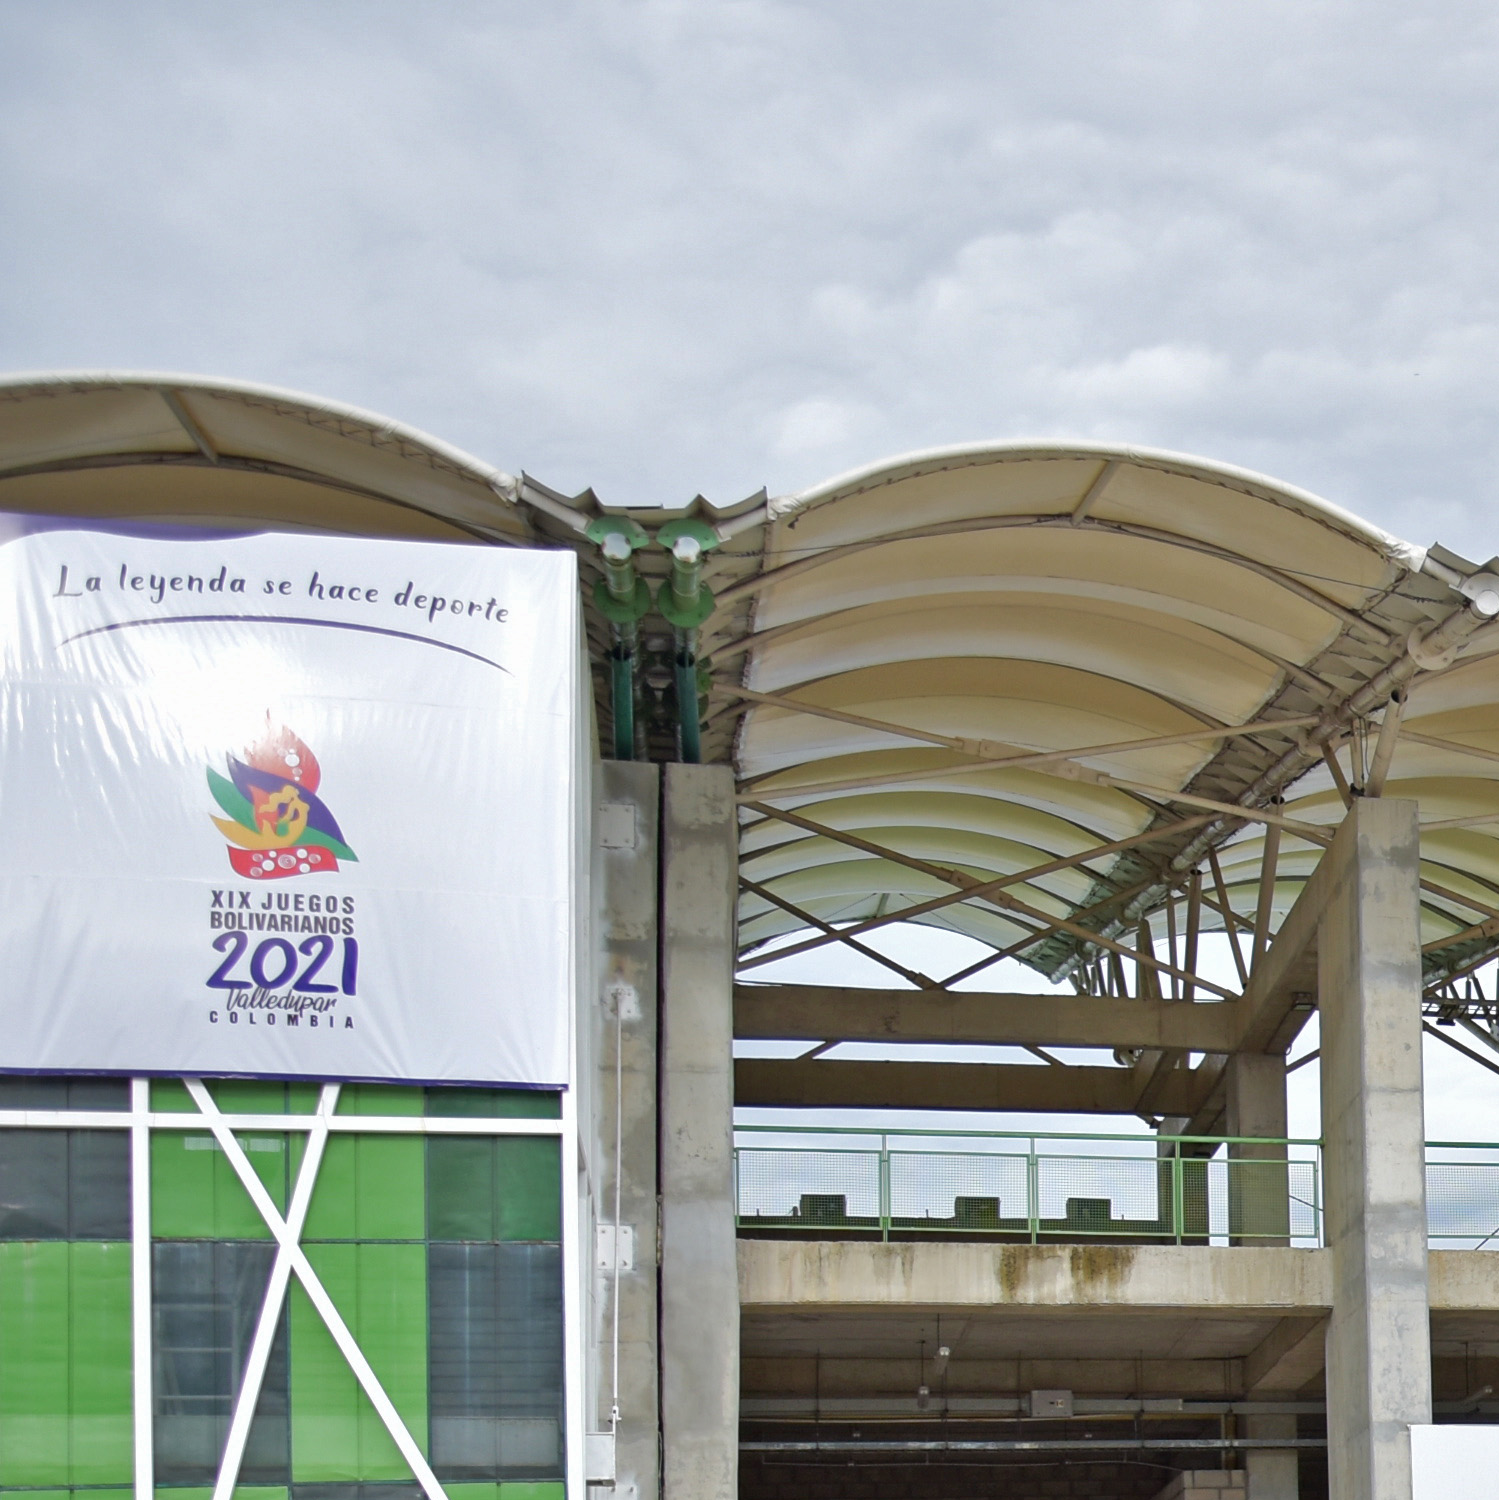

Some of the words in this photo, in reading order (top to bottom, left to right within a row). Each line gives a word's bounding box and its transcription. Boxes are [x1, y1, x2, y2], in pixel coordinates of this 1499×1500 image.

[53, 565, 102, 598] La
[119, 564, 246, 604] leyenda
[263, 577, 292, 595] se
[309, 572, 379, 603] hace
[394, 582, 509, 624] deporte
[211, 890, 251, 909] XIX
[261, 892, 354, 914] JUEGOS
[210, 911, 354, 935] BOLIVARIANOS
[206, 930, 358, 996] 2021
[227, 988, 337, 1018] Valledupar
[210, 1011, 354, 1028] COLOMBIA
